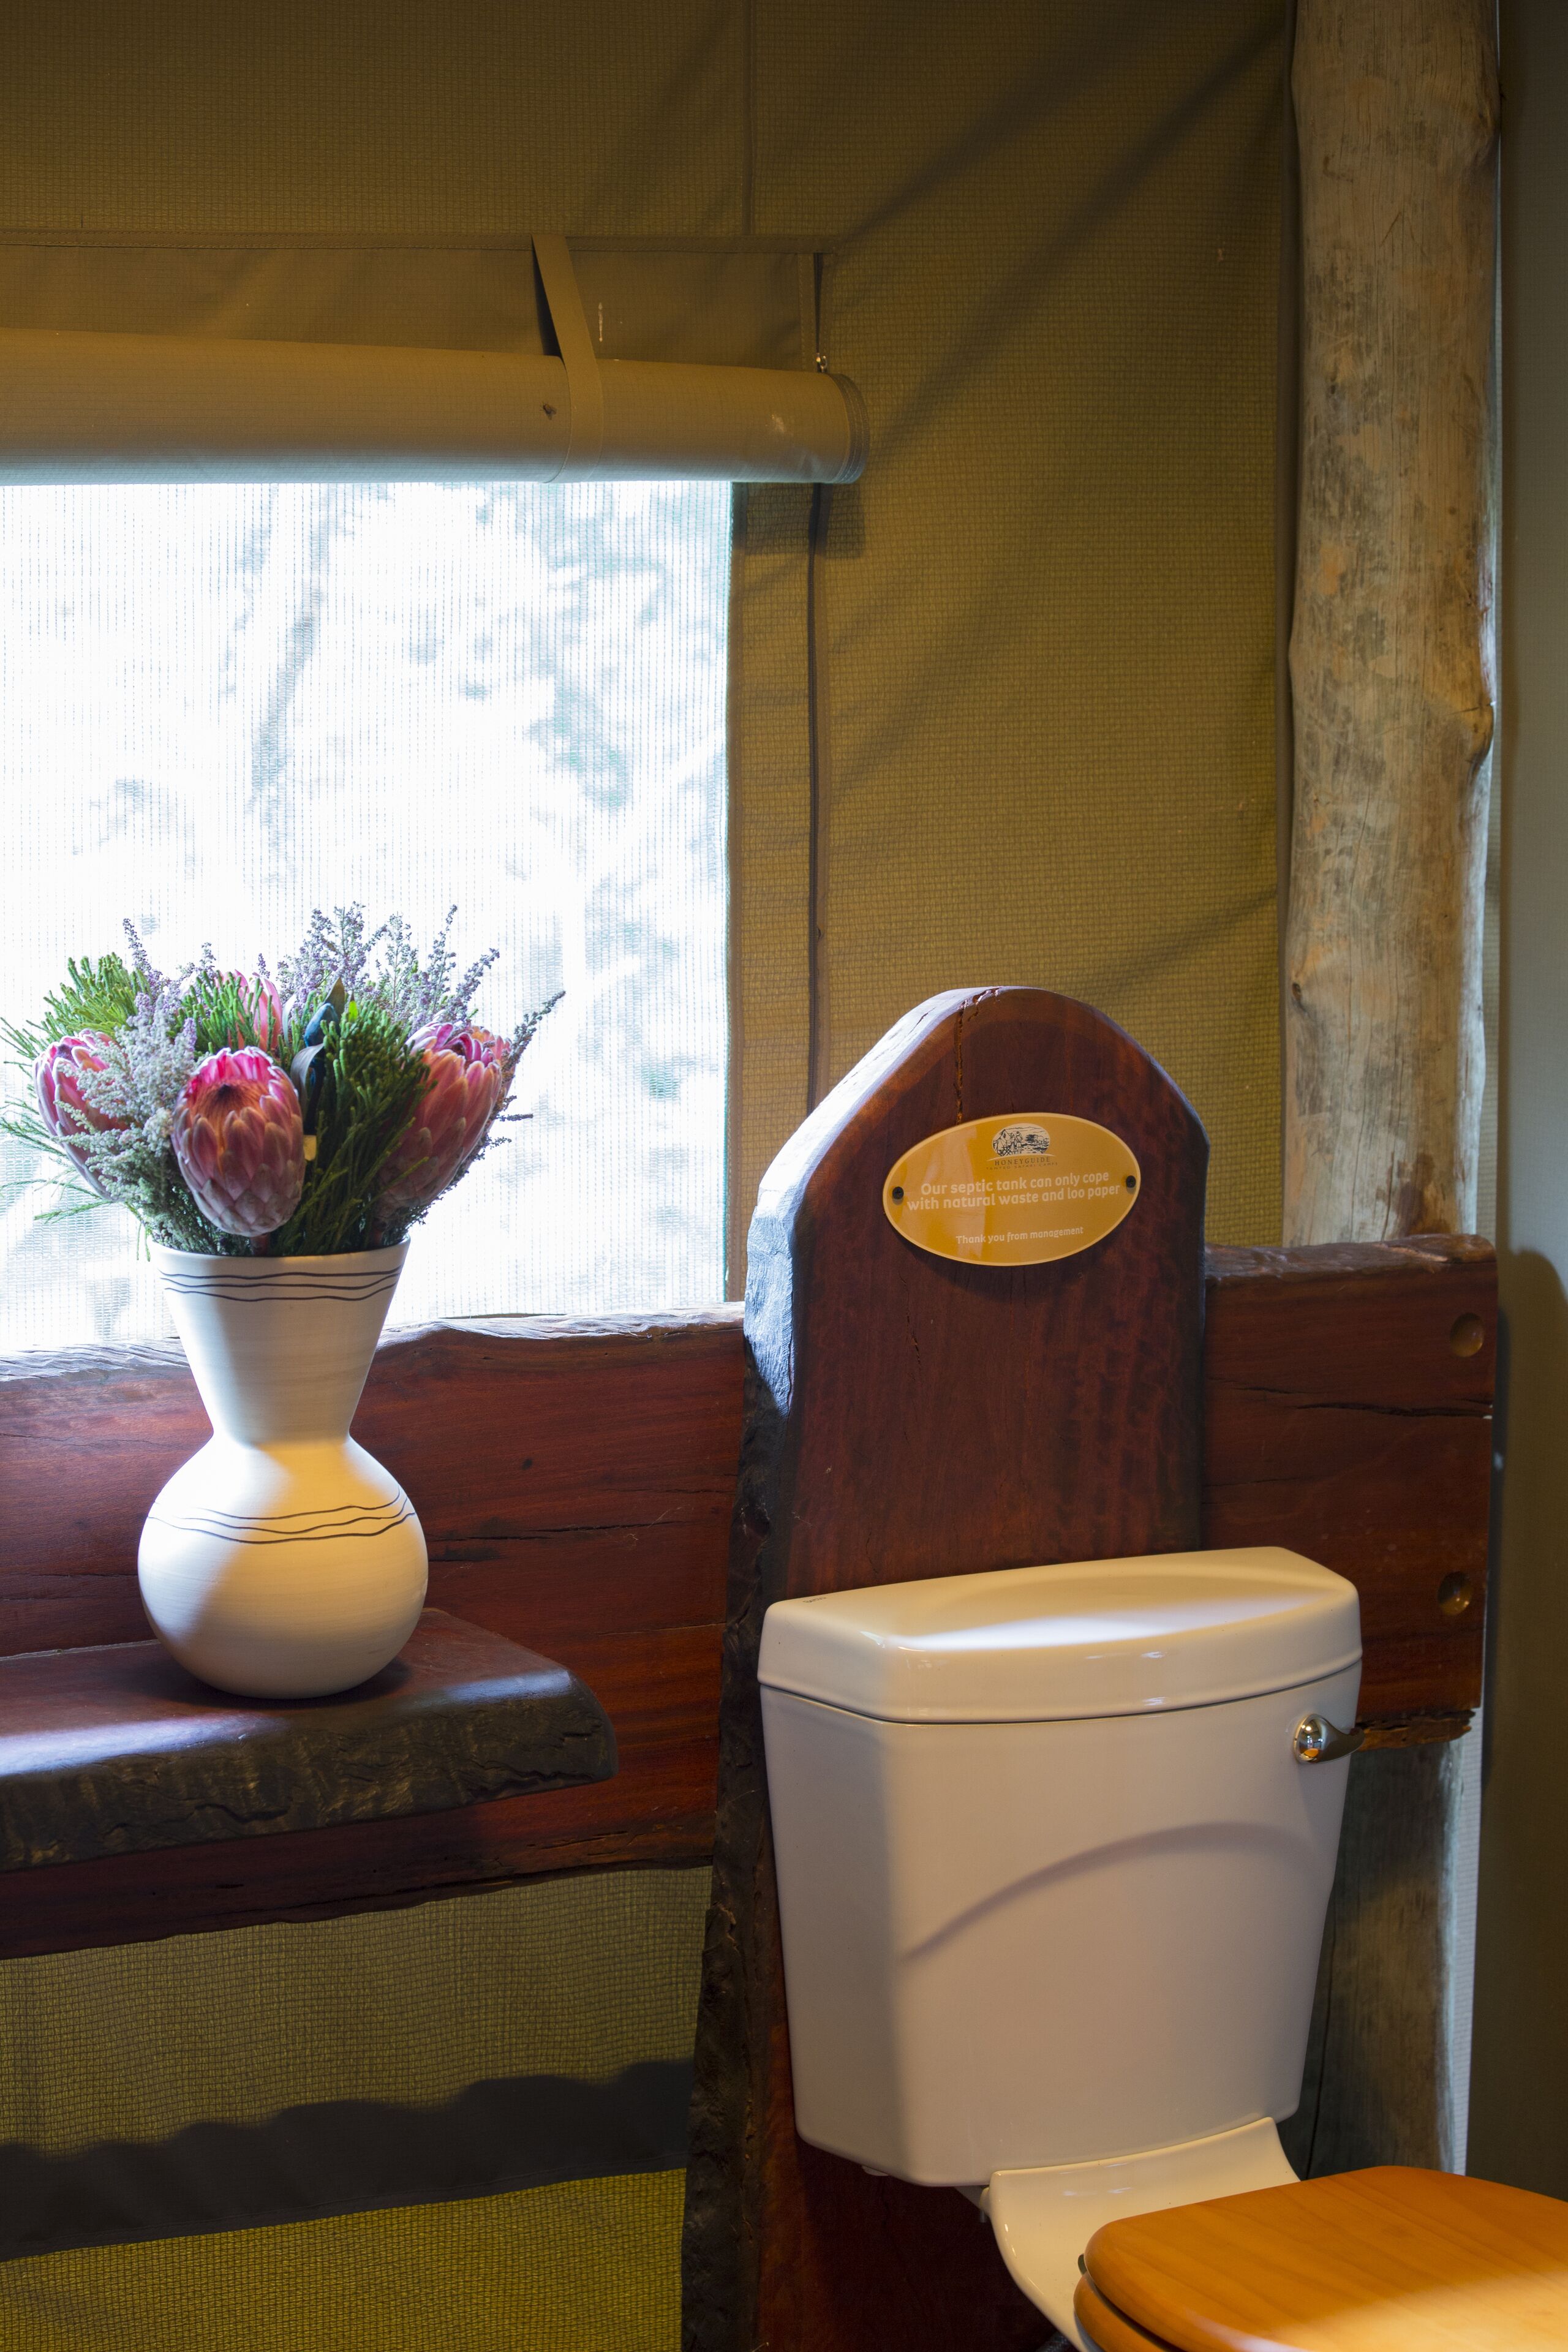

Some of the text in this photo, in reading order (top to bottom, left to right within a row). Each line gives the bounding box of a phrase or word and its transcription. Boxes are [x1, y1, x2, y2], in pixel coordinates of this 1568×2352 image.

[995, 1156, 1050, 1166] HONEYGUIDE
[921, 1172, 1109, 1196] Our septic tank can only cope
[907, 1185, 1120, 1211] with natural waste and loo paper
[956, 1227, 1084, 1244] Thank you from management
